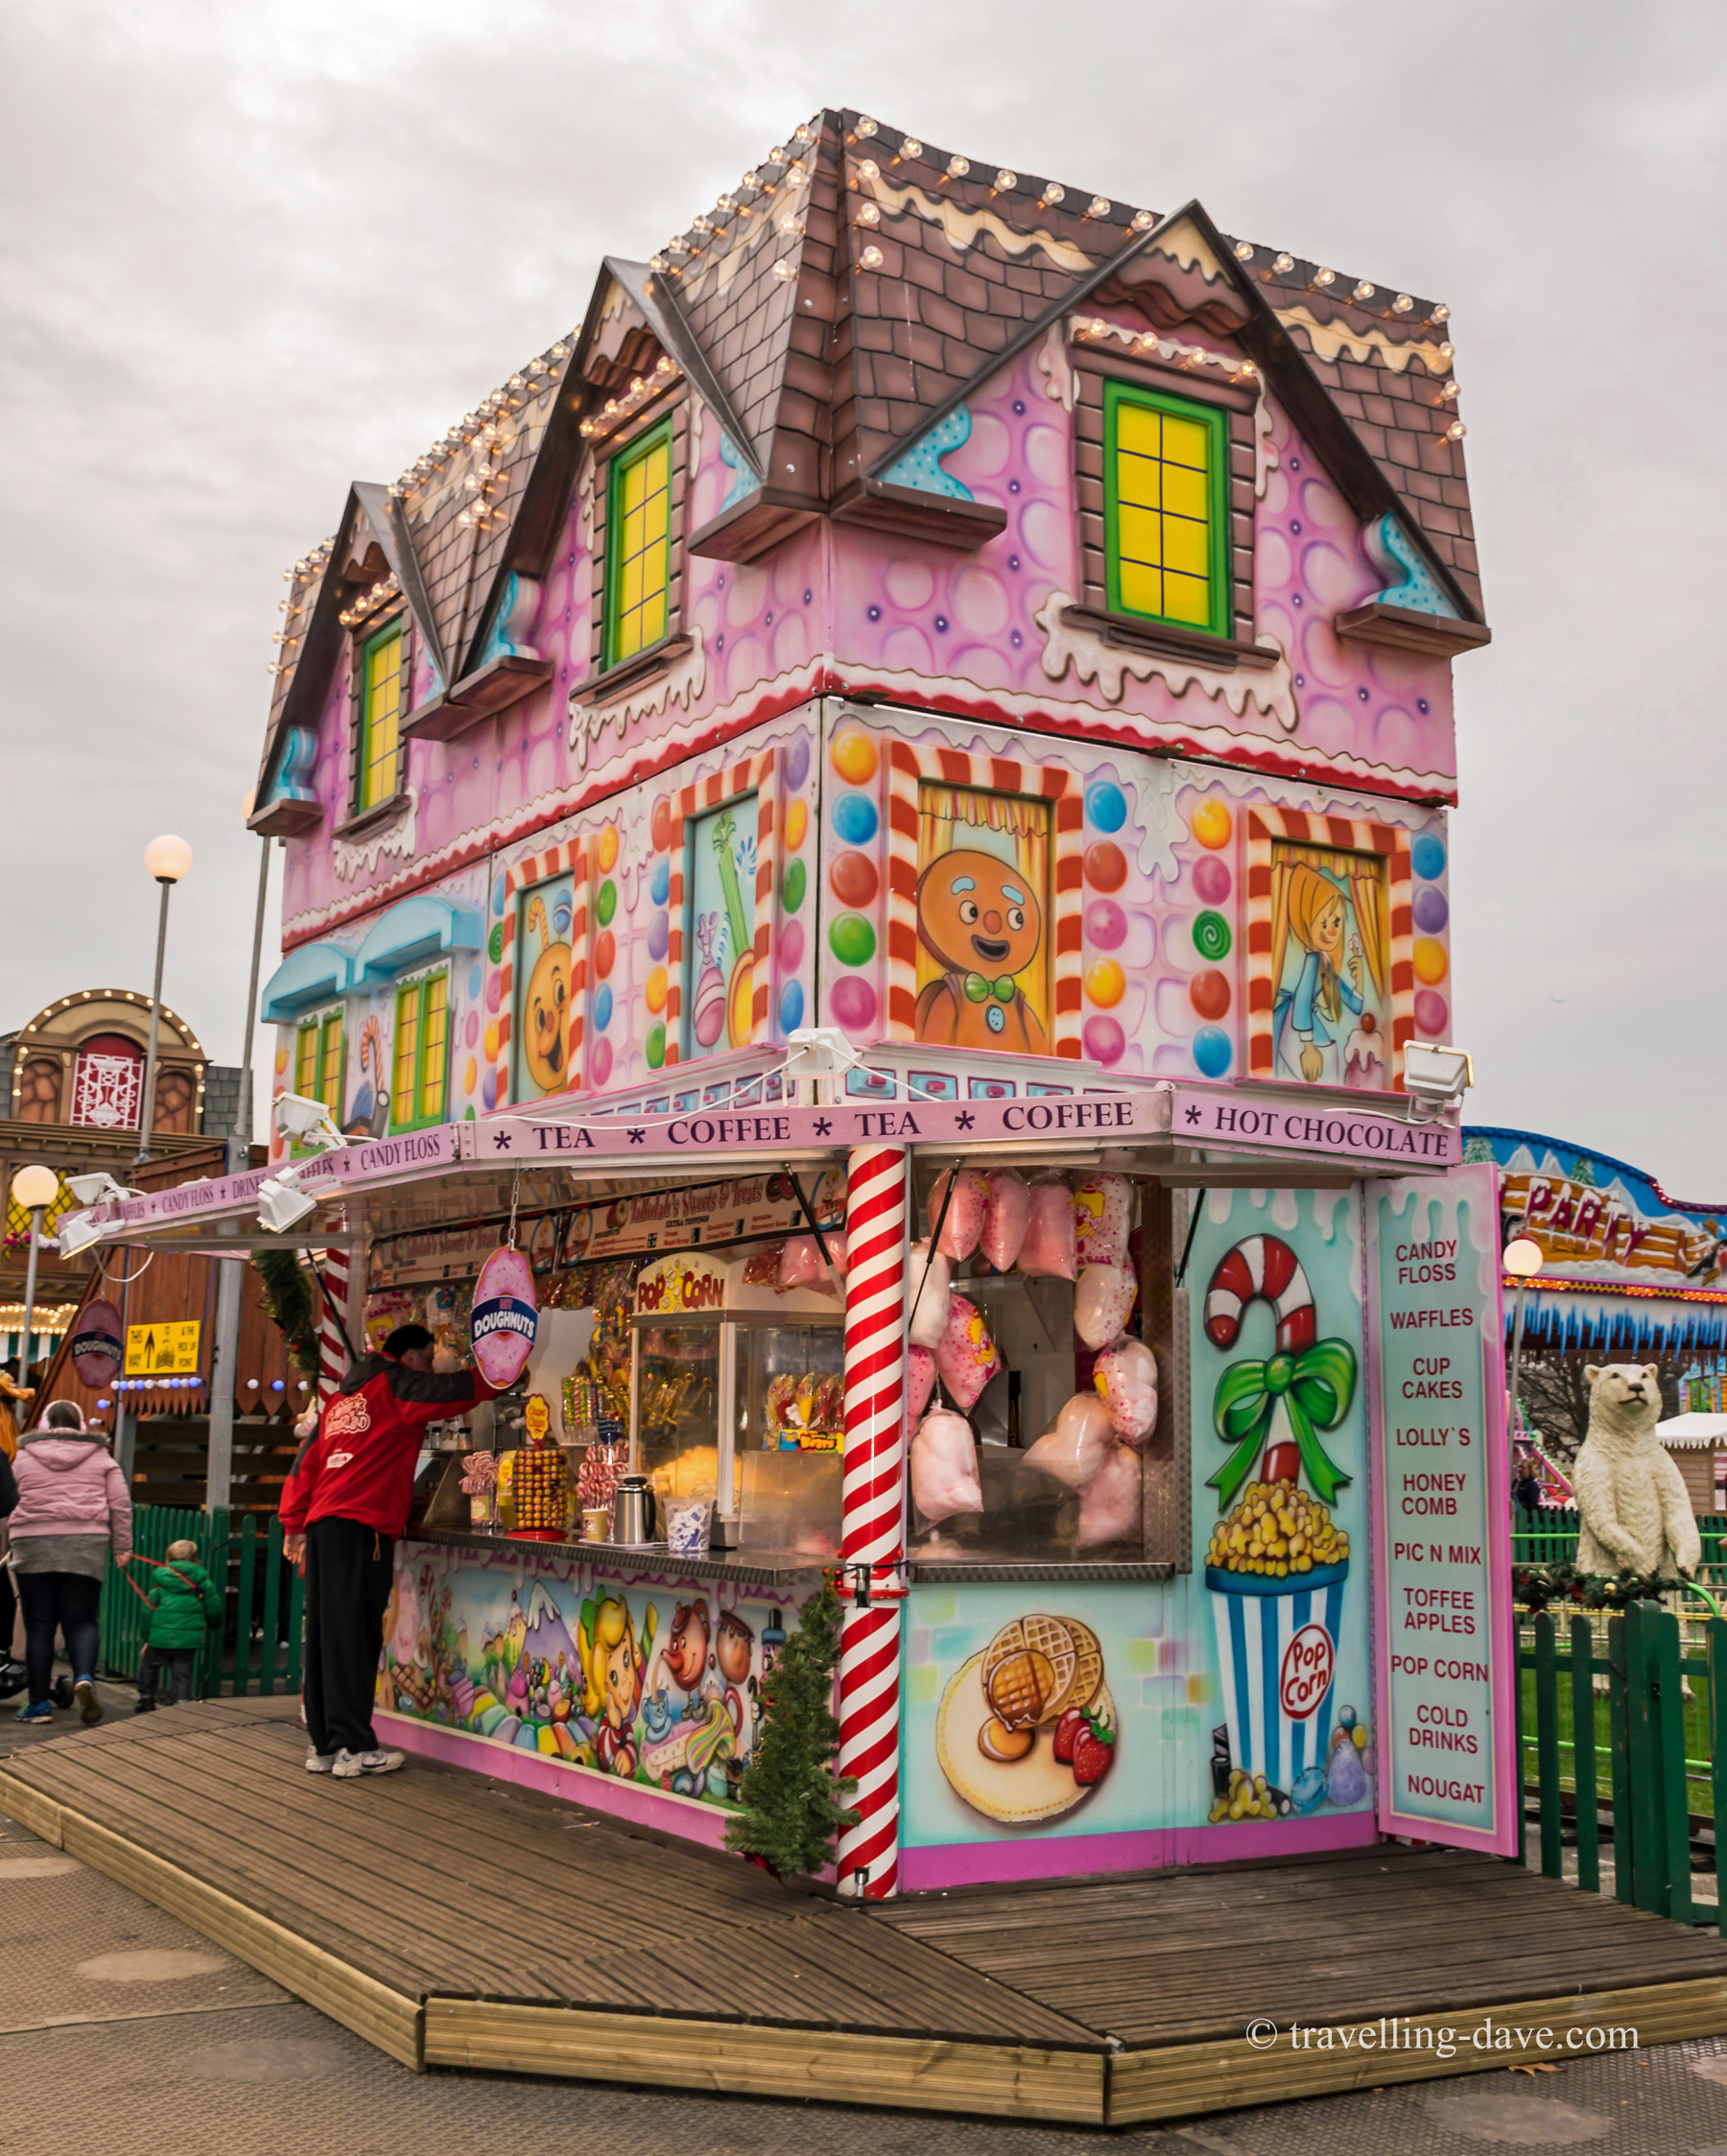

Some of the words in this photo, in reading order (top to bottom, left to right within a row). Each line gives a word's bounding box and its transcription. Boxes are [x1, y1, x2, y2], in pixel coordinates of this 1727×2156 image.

[532, 1126, 596, 1150] TEA
[668, 1116, 792, 1145] COFFEE
[854, 1110, 922, 1137] TEA
[1003, 1102, 1134, 1130] COFFEE
[1215, 1106, 1278, 1136] HOT
[1284, 1115, 1450, 1157] CHOCOLATE
[162, 1194, 189, 1214] CANDY
[190, 1185, 214, 1208] FLOSS
[298, 1156, 335, 1180] AFFLES
[361, 1141, 402, 1171] CANDY
[405, 1133, 440, 1162] FLOSS
[681, 1186, 717, 1218] Sweets
[719, 1180, 729, 1209] &
[731, 1176, 764, 1208] Treats
[1525, 1176, 1651, 1266] PARTY
[1396, 1240, 1457, 1262] CANDY
[1399, 1263, 1456, 1284] FLOSS
[638, 1273, 666, 1313] POP
[681, 1270, 724, 1309] CORN
[474, 1311, 535, 1339] DOUGHNUTS
[1390, 1308, 1474, 1329] WAFFLES
[1412, 1358, 1451, 1376] CUP
[1402, 1381, 1463, 1399] CAKES
[1403, 1474, 1466, 1492] HONEY
[1402, 1497, 1457, 1515] COMB
[1394, 1543, 1424, 1562] PIC
[1430, 1544, 1442, 1562] N
[1449, 1545, 1481, 1565] MIX
[1403, 1587, 1475, 1610] TOFFEE
[1404, 1612, 1476, 1635] APPLES
[1391, 1655, 1428, 1675] POP
[1433, 1659, 1488, 1682] CORN
[1286, 1669, 1327, 1707] Corn
[1417, 1704, 1468, 1727] COLD
[1408, 1727, 1479, 1754] DRINKS
[1408, 1774, 1484, 1803] NOUGAT
